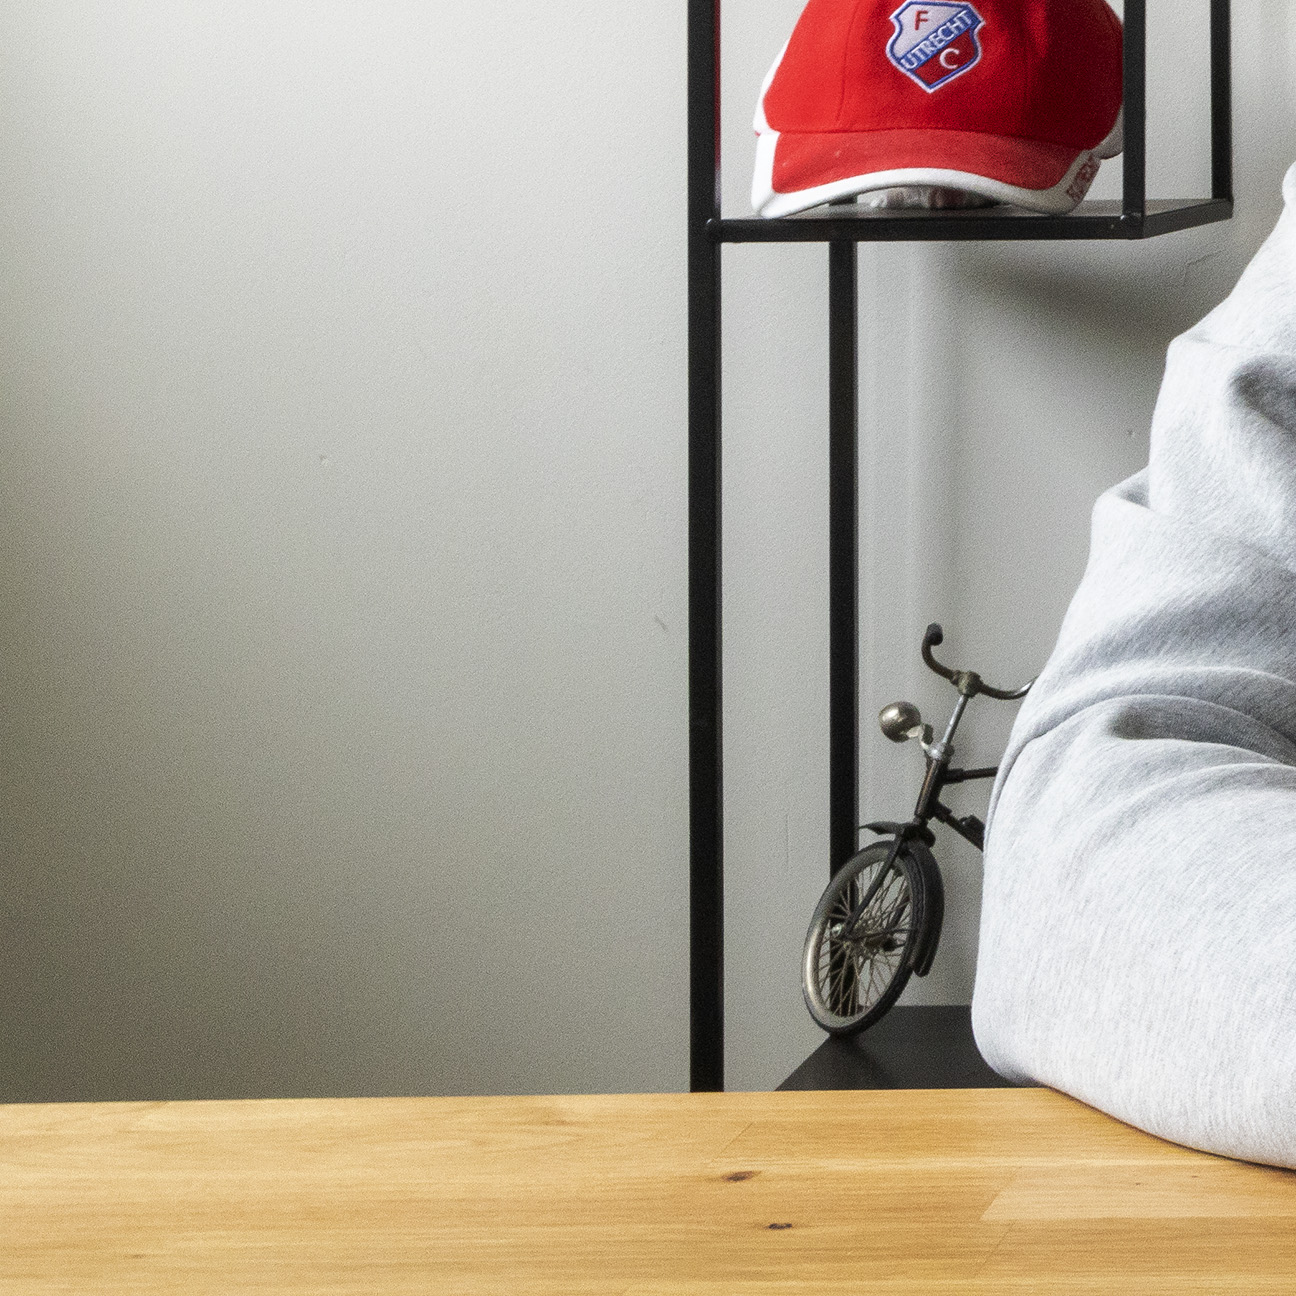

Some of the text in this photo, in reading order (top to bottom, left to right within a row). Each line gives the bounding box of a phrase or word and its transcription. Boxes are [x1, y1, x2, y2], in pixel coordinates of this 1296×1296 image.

[914, 10, 928, 31] F
[900, 10, 972, 70] UTRECHT
[939, 47, 960, 70] C
